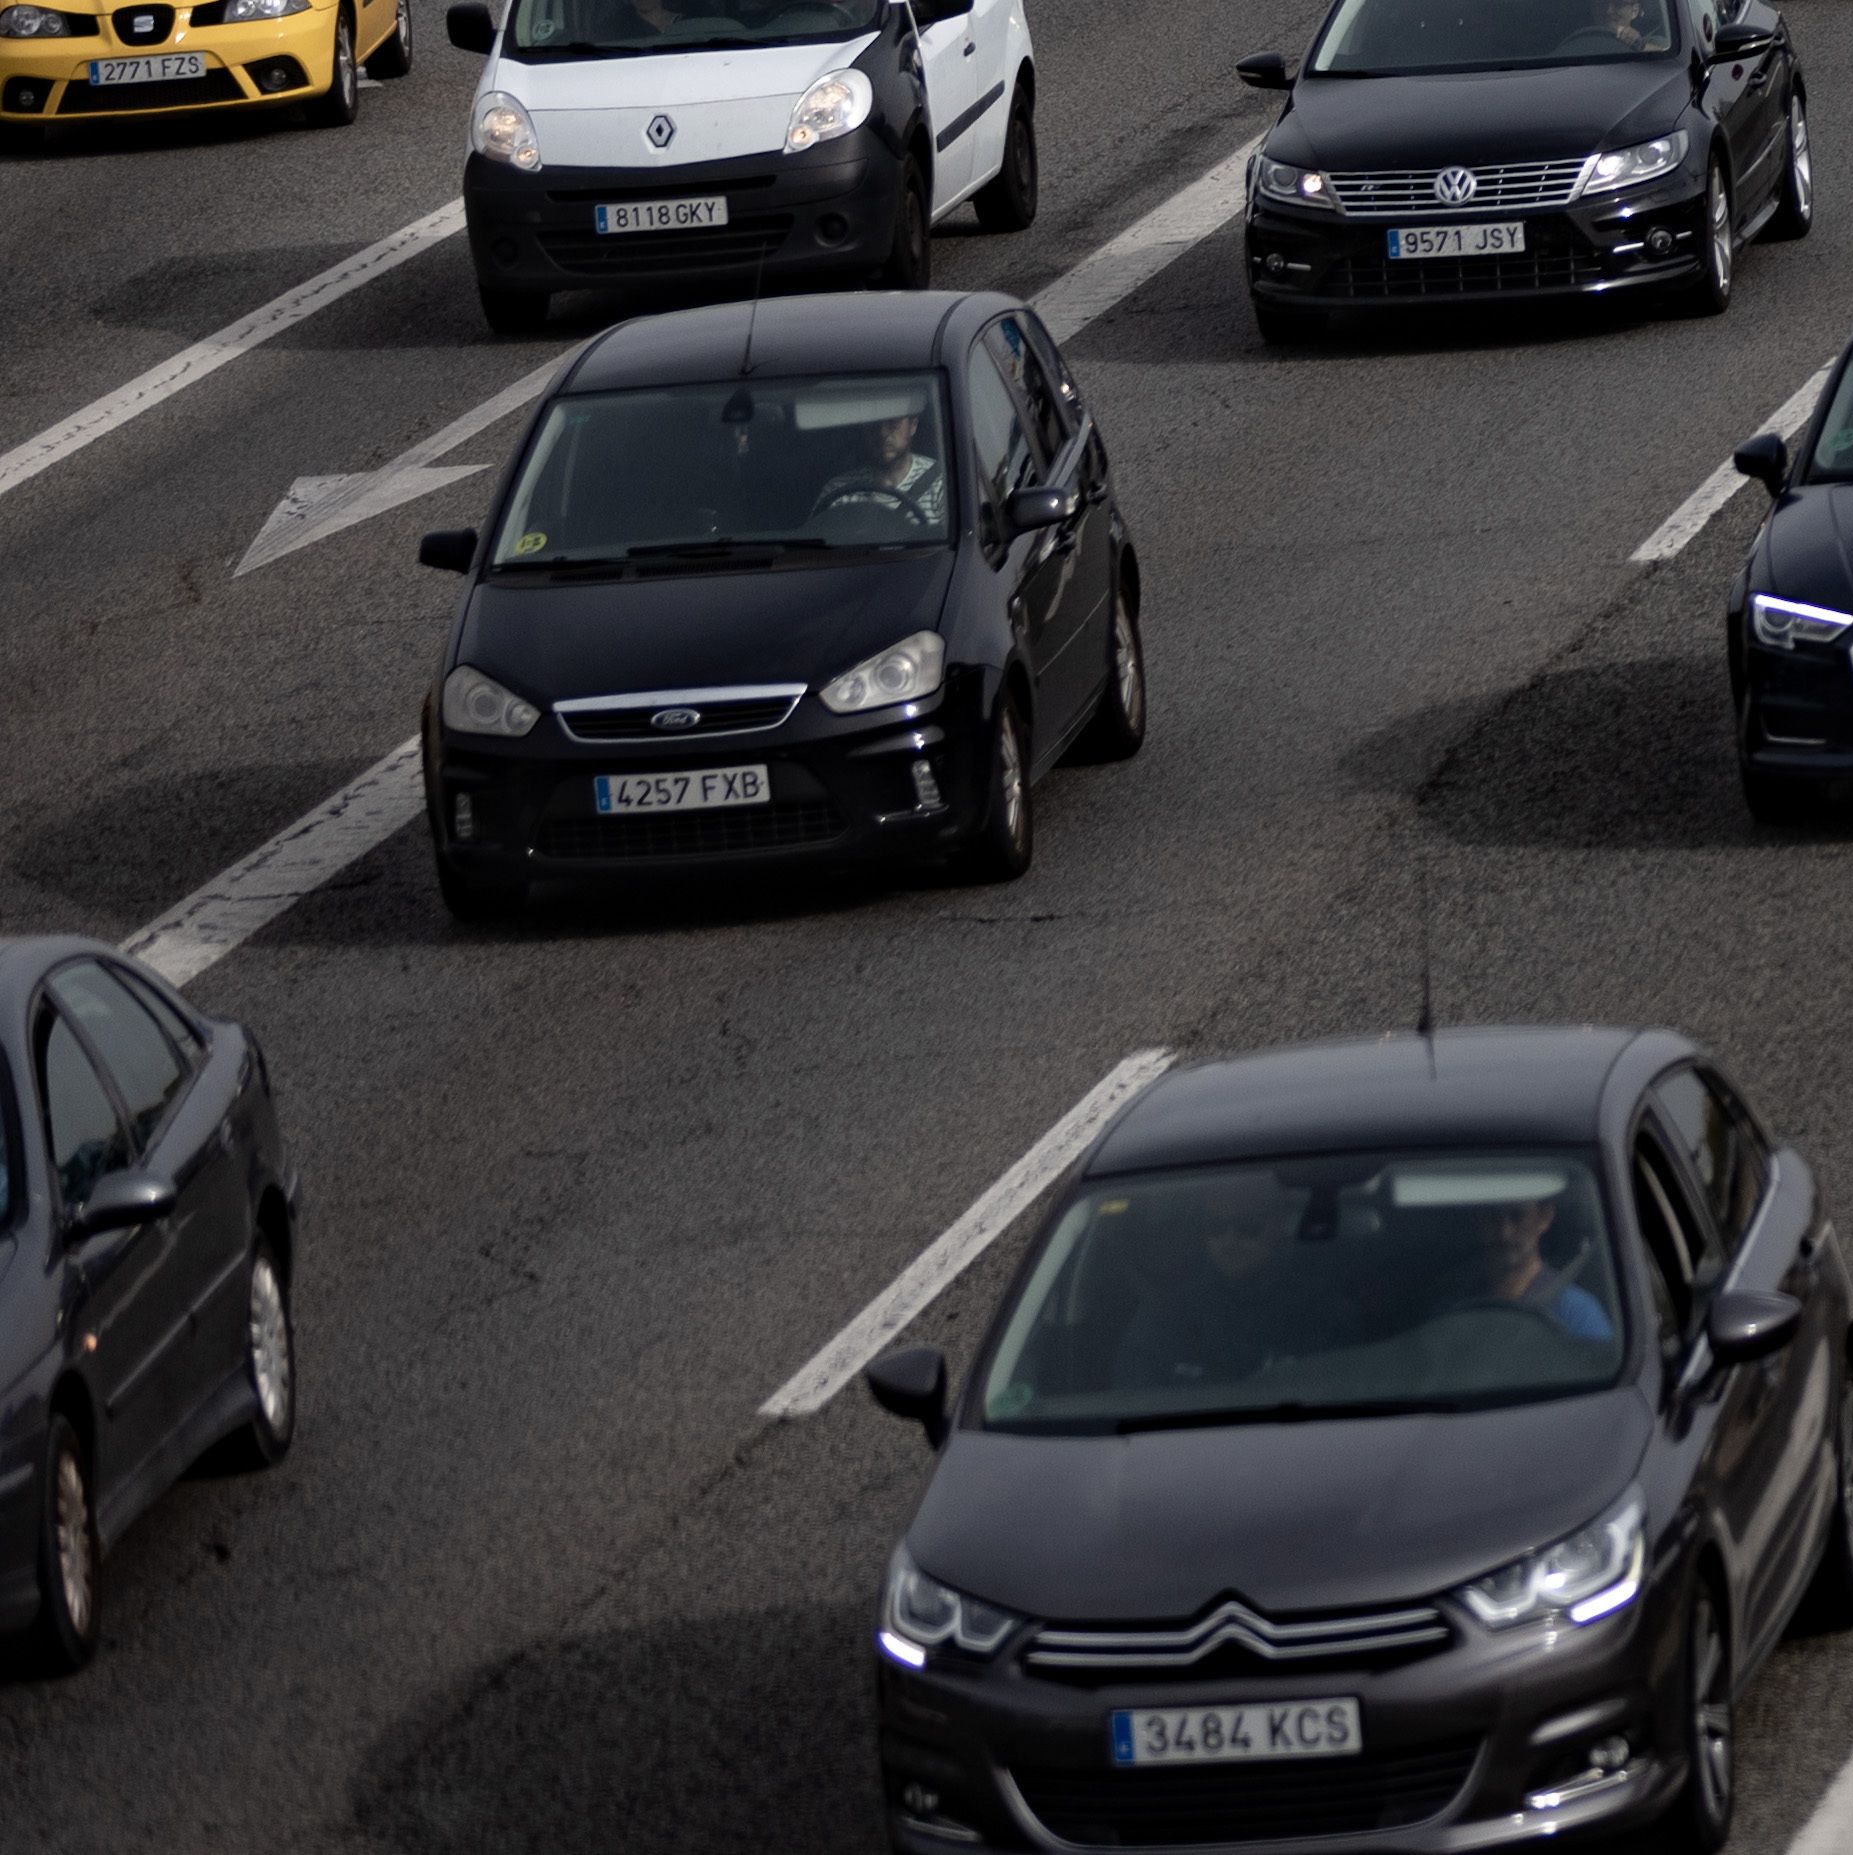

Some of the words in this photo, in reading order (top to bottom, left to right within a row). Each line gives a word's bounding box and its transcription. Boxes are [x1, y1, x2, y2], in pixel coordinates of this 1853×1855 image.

[104, 59, 153, 82] 2771
[161, 56, 200, 77] FZS
[616, 204, 671, 228] 8118
[675, 201, 716, 225] GKY
[1405, 229, 1463, 254] 9571
[1476, 226, 1518, 251] JSY
[617, 776, 691, 807] 4257
[701, 770, 761, 802] FXB
[1145, 1711, 1252, 1758] 3484
[1267, 1704, 1350, 1748] KCS
